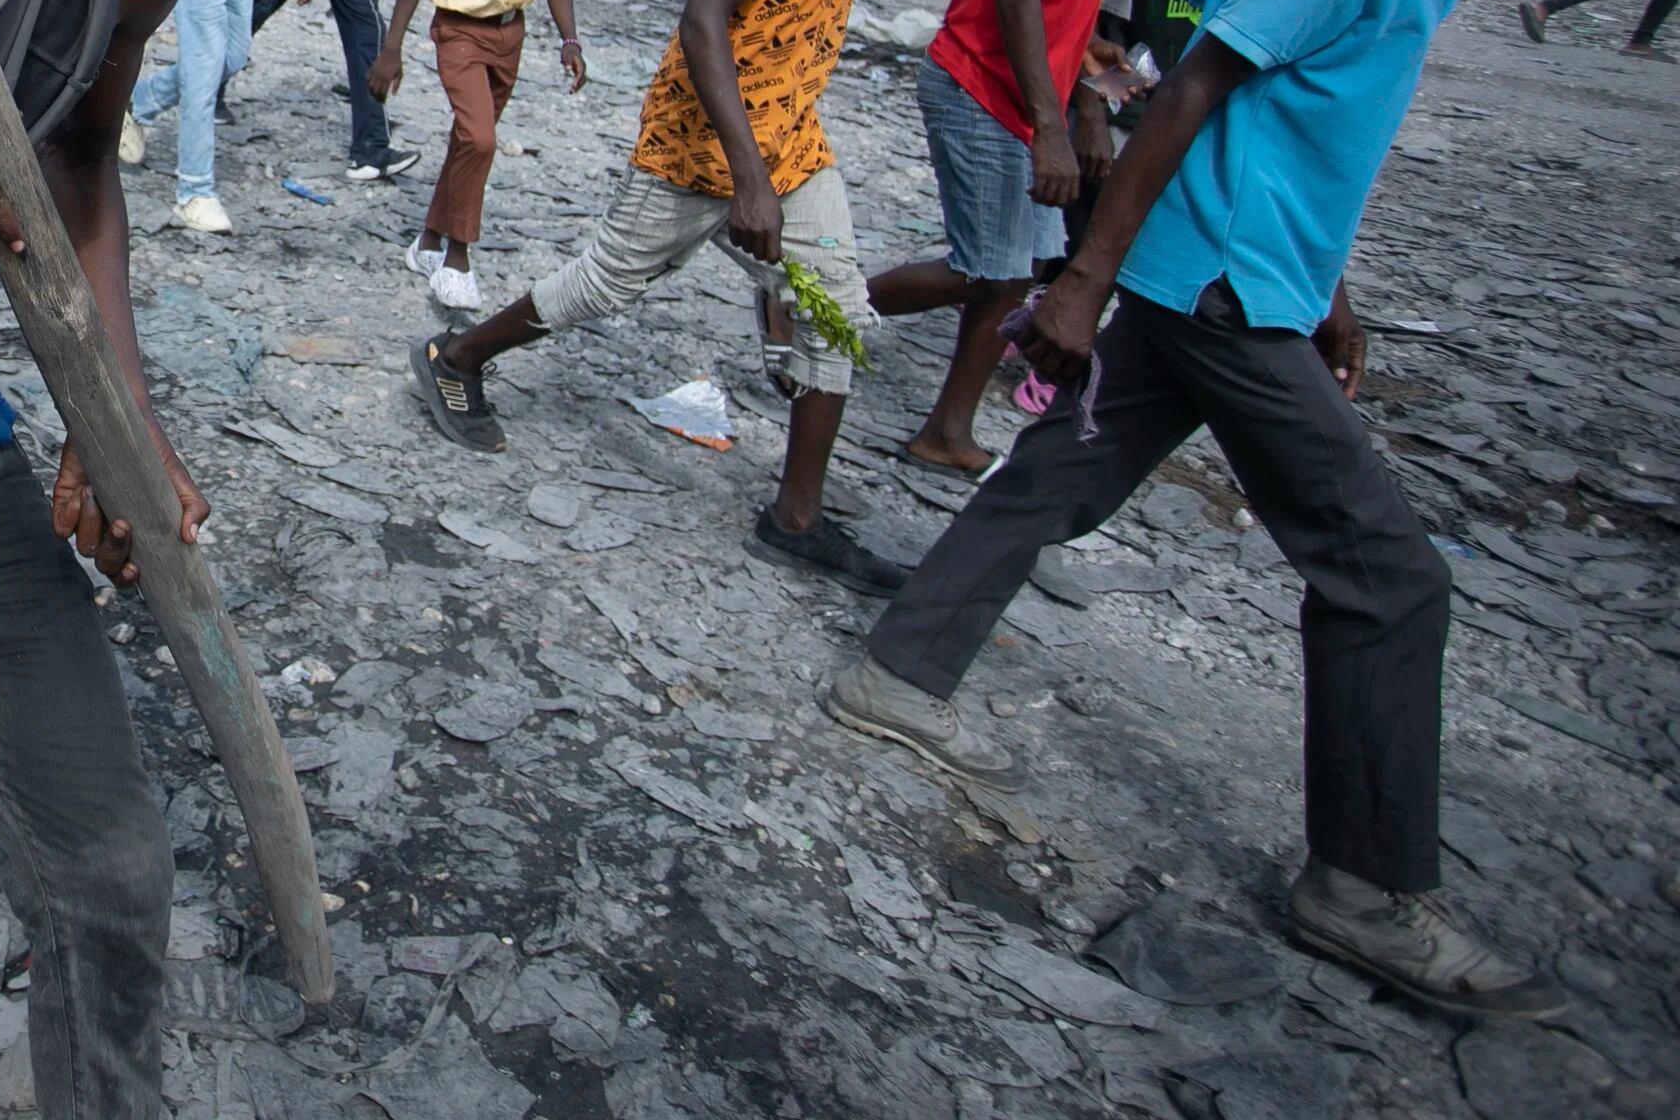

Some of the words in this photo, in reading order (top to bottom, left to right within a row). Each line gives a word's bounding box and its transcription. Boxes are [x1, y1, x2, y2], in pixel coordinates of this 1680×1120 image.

[754, 2, 800, 22] adidas
[741, 77, 785, 93] adidas
[641, 147, 678, 157] adidas
